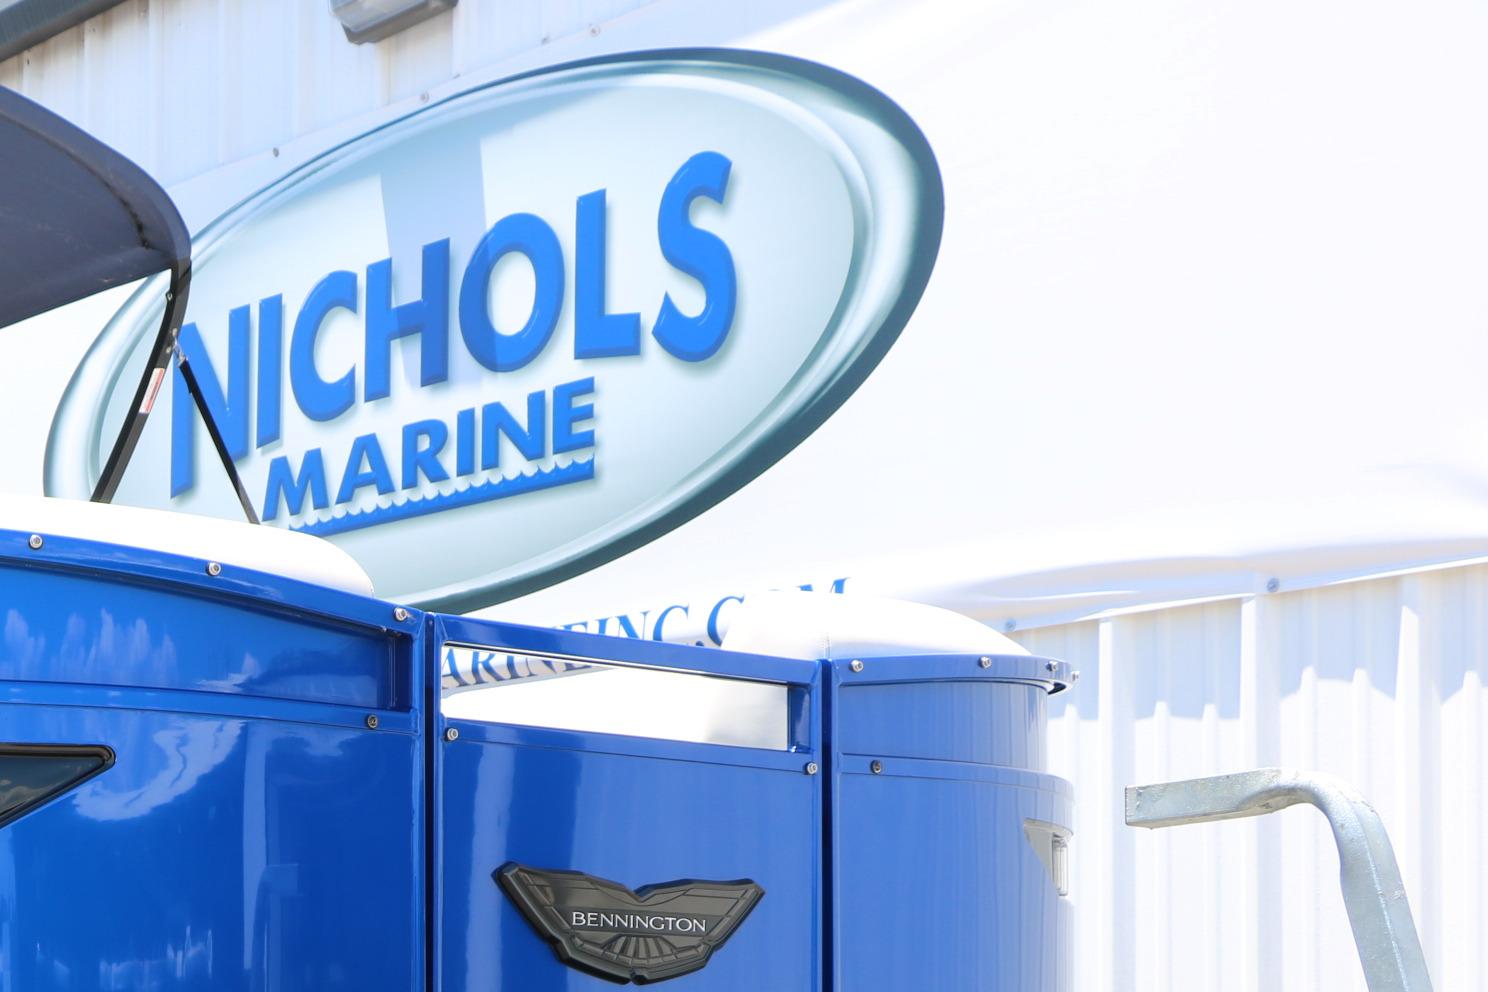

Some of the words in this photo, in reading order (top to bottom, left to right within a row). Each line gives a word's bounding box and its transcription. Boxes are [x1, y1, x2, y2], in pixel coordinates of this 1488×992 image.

[170, 150, 738, 500] NICHOLS
[262, 376, 597, 523] MARINE
[571, 910, 707, 933] BENNINGTON
